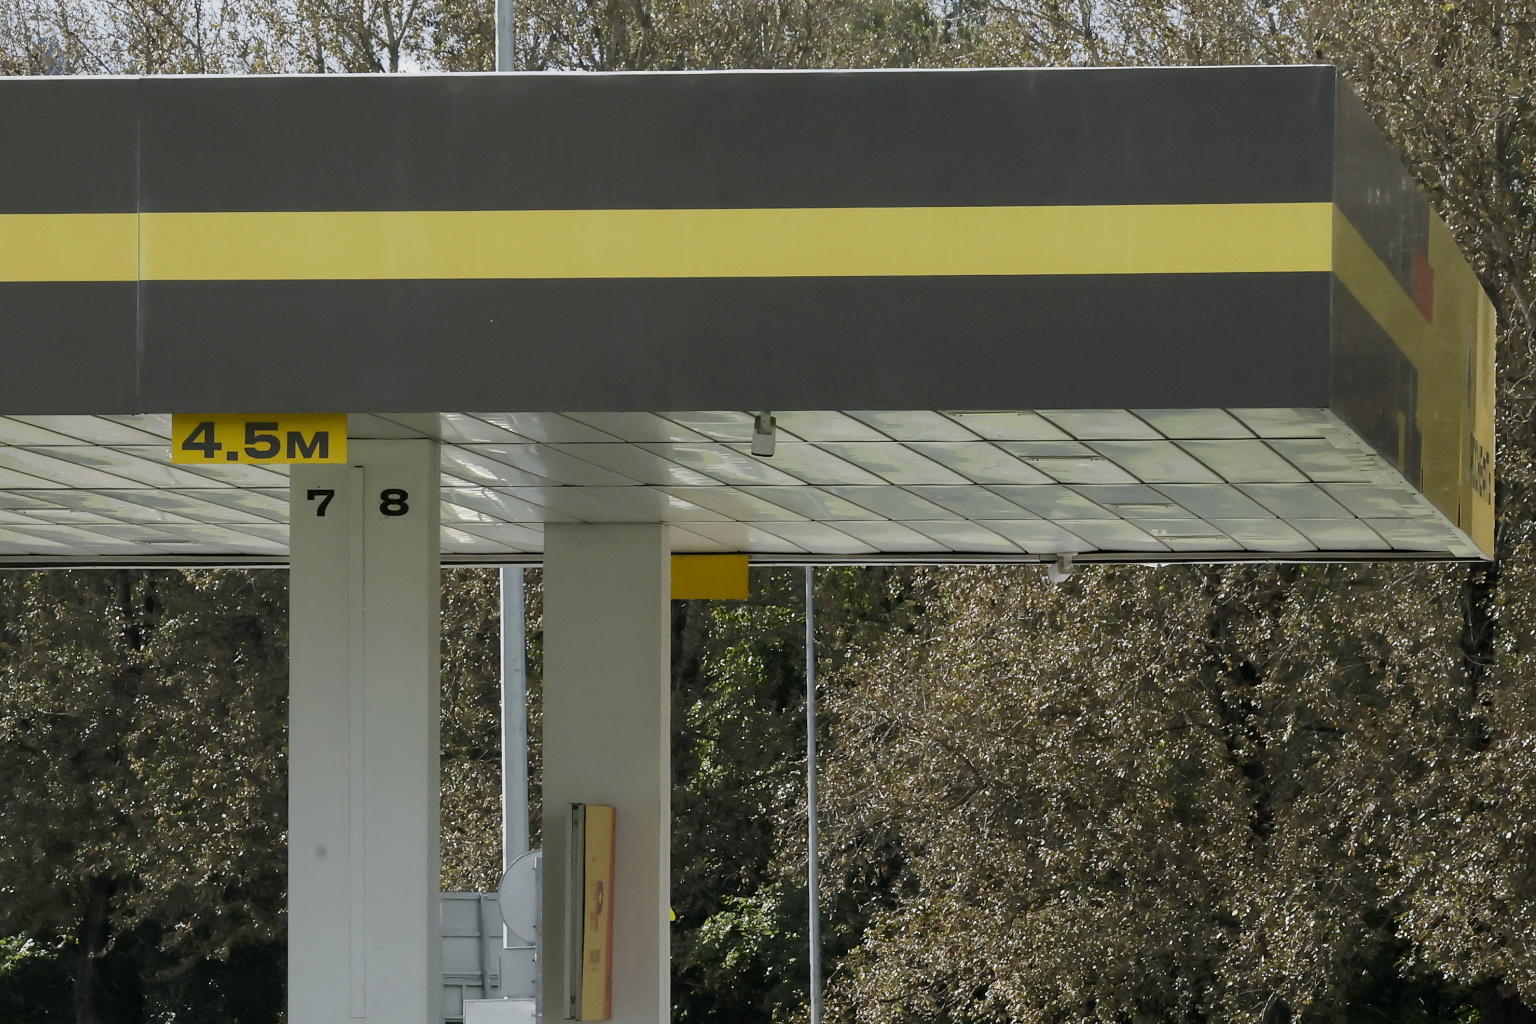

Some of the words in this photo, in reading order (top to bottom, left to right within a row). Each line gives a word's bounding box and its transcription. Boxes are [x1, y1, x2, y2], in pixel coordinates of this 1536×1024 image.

[181, 421, 329, 461] 4.5М
[306, 489, 335, 517] 7
[379, 488, 409, 517] 8
